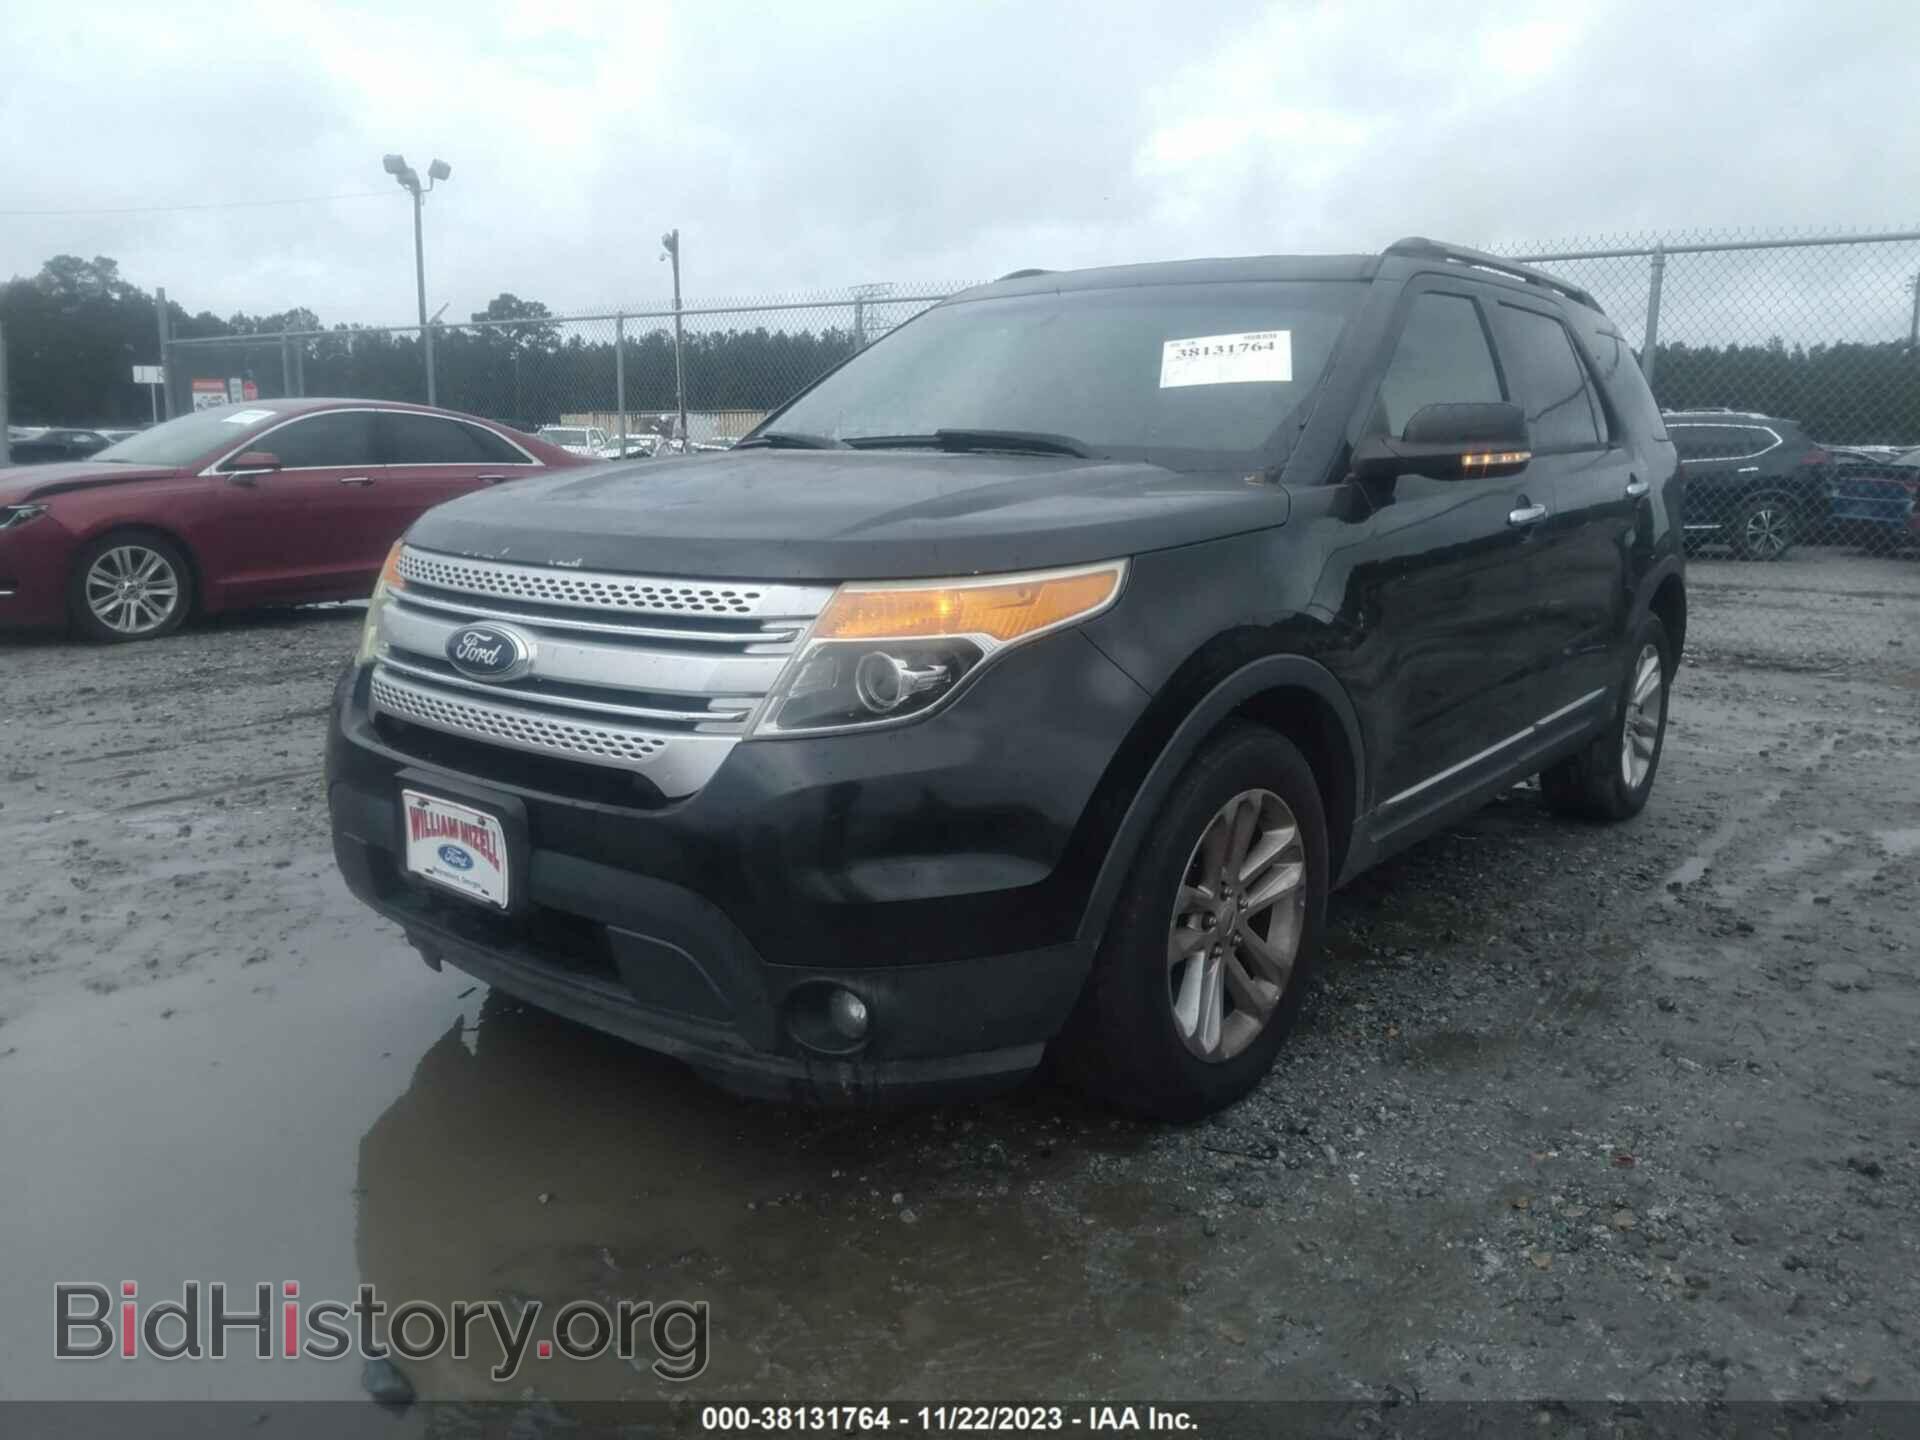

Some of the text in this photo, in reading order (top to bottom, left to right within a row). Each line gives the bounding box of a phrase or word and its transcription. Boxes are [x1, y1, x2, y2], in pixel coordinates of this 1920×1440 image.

[1175, 341, 1275, 359] 38131764
[456, 631, 502, 666] Ford
[409, 806, 460, 842] WILLIAM
[443, 847, 469, 868] Ford
